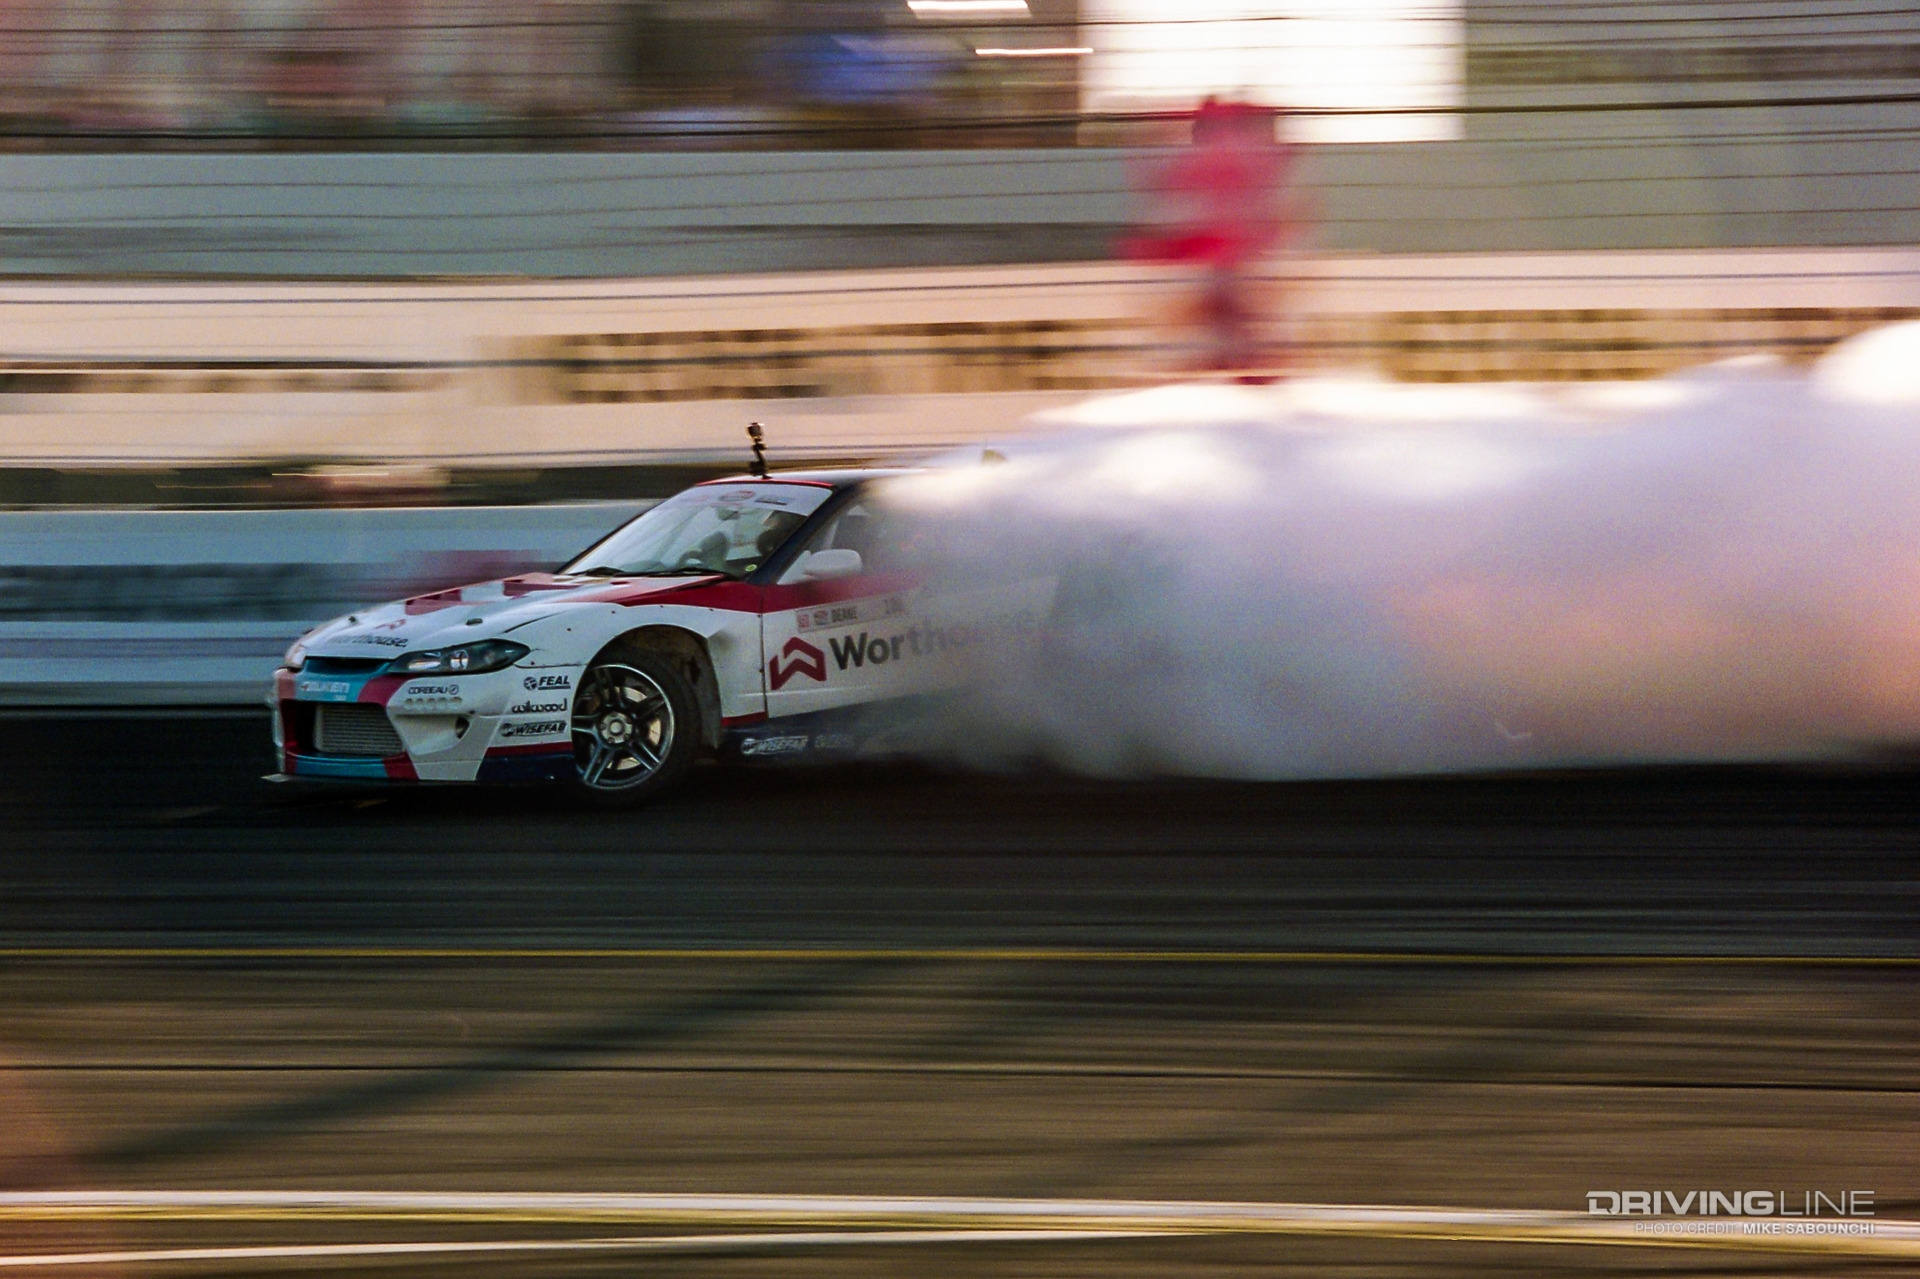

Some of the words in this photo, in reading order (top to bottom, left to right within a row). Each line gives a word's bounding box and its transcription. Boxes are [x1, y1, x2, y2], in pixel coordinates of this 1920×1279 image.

[538, 675, 571, 686] FEAL
[407, 685, 448, 695] CORBEAU
[511, 698, 568, 714] wilwood
[515, 721, 567, 735] WISEFAB
